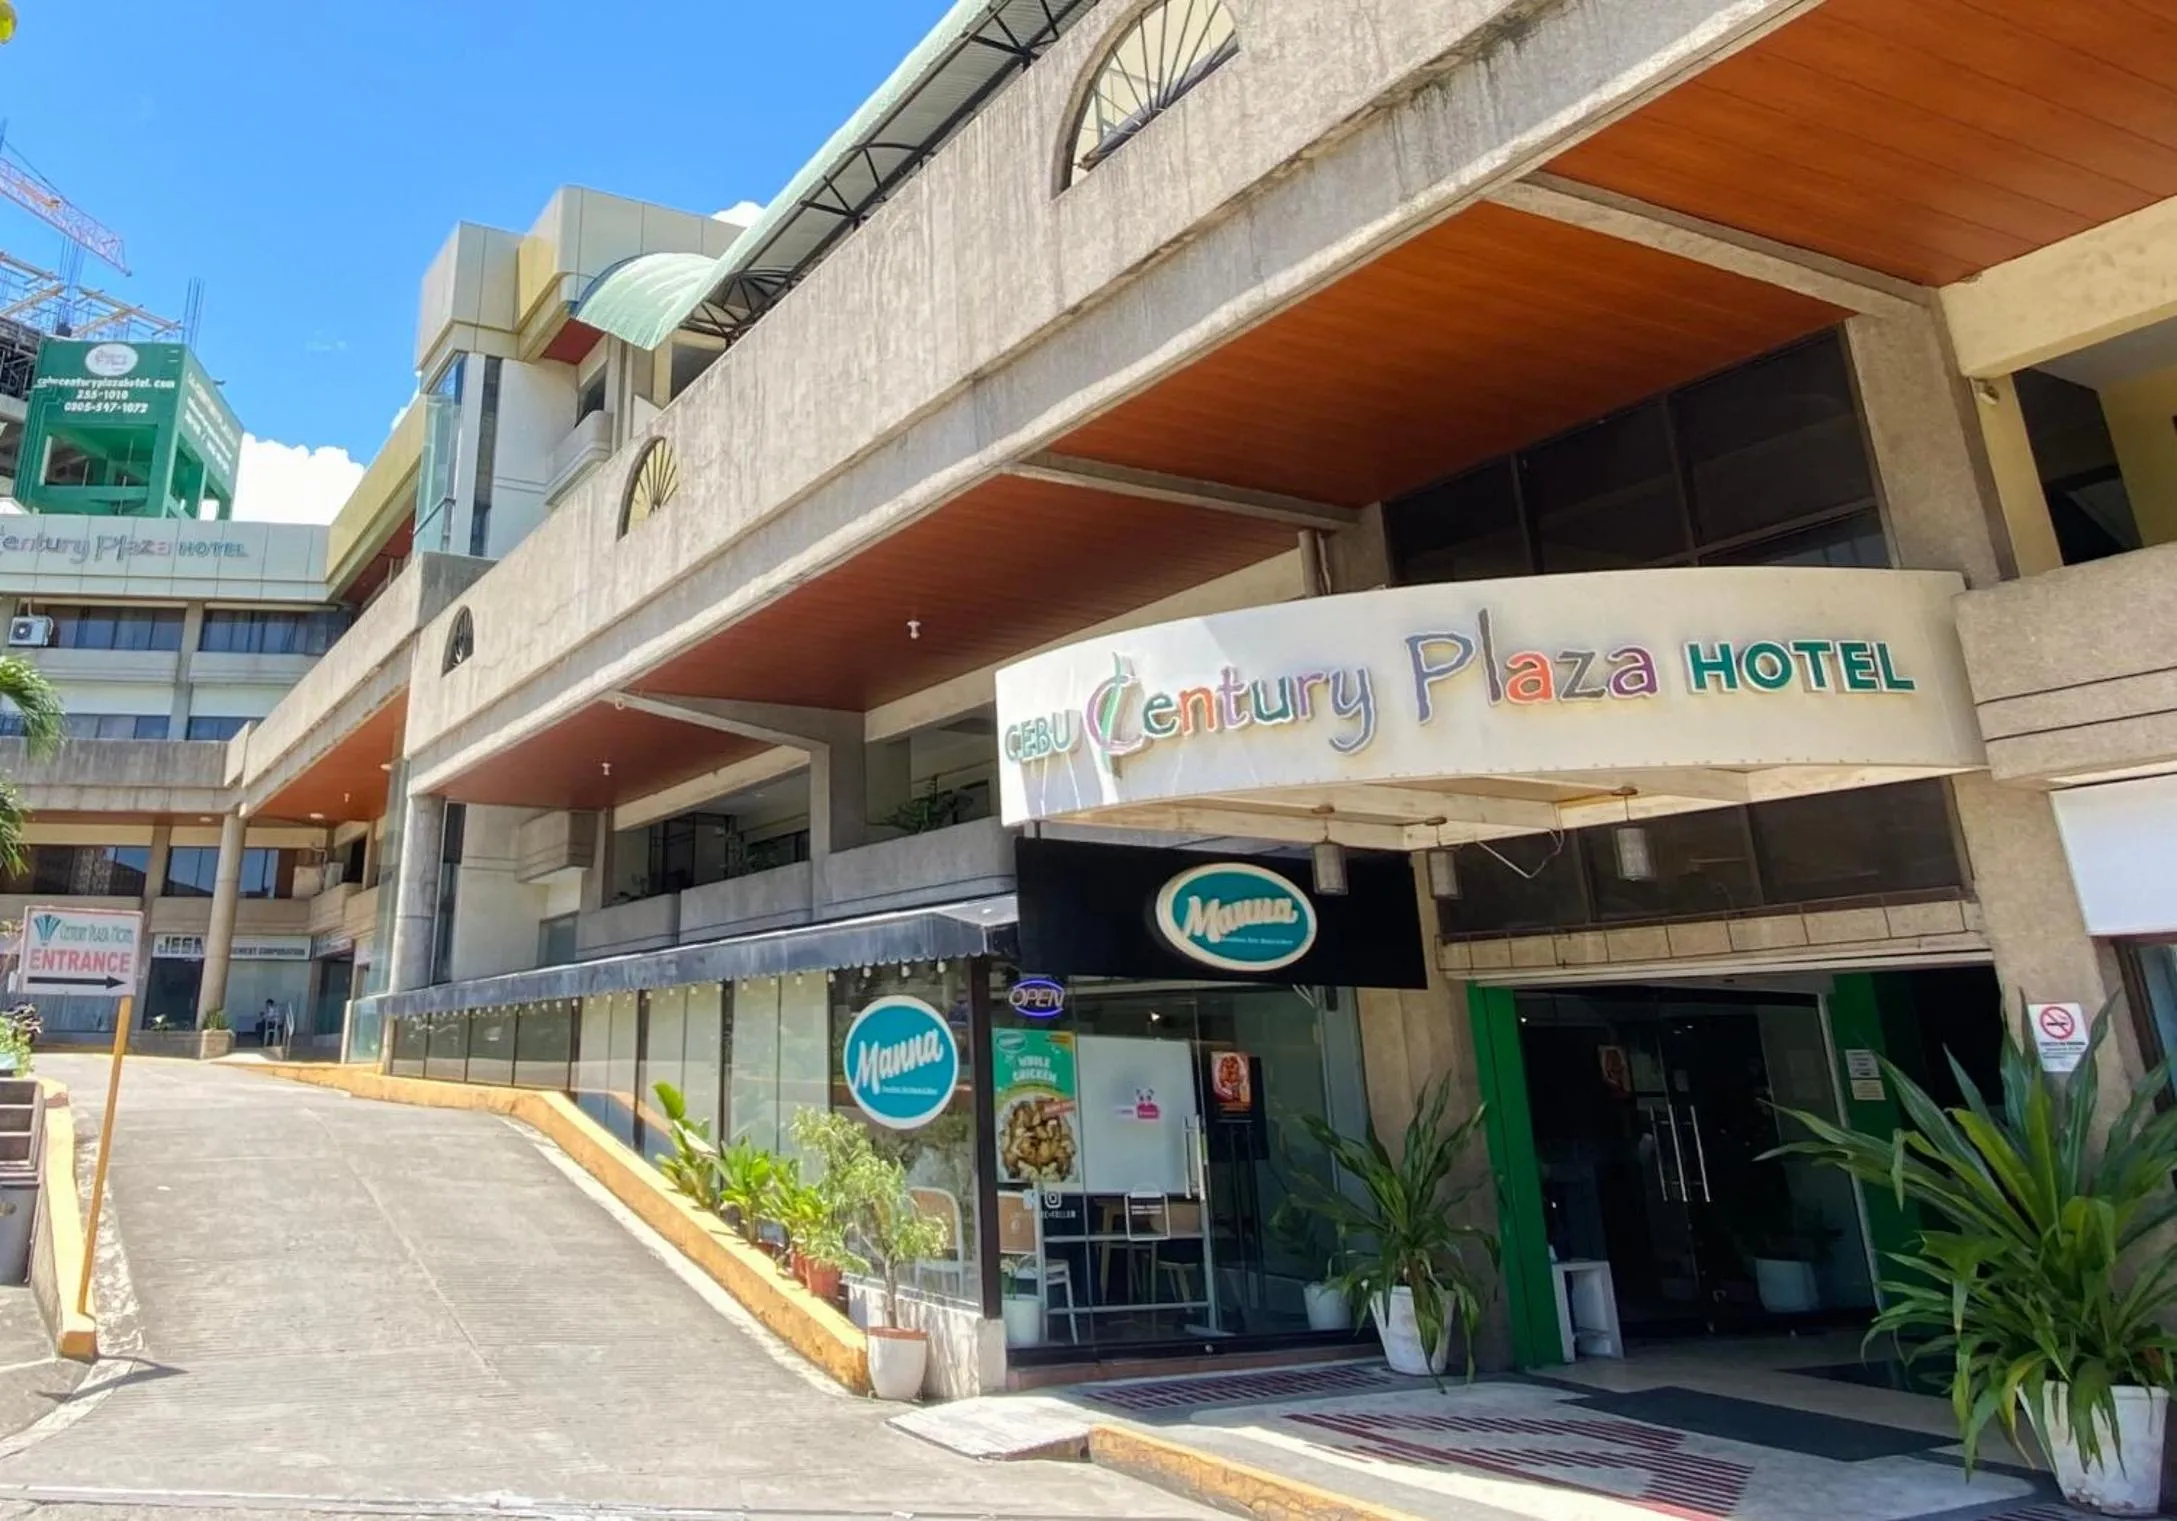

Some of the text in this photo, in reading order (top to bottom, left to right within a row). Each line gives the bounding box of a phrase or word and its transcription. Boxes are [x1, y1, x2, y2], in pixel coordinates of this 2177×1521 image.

[0, 524, 249, 564] entury Plaza HOTEL
[1004, 606, 1916, 774] CEBU Century Plaza HOTEL
[1183, 895, 1299, 943] Manna
[29, 948, 132, 973] ENTRANCE
[1009, 989, 1065, 1008] OPEN
[853, 1028, 944, 1095] Manna
